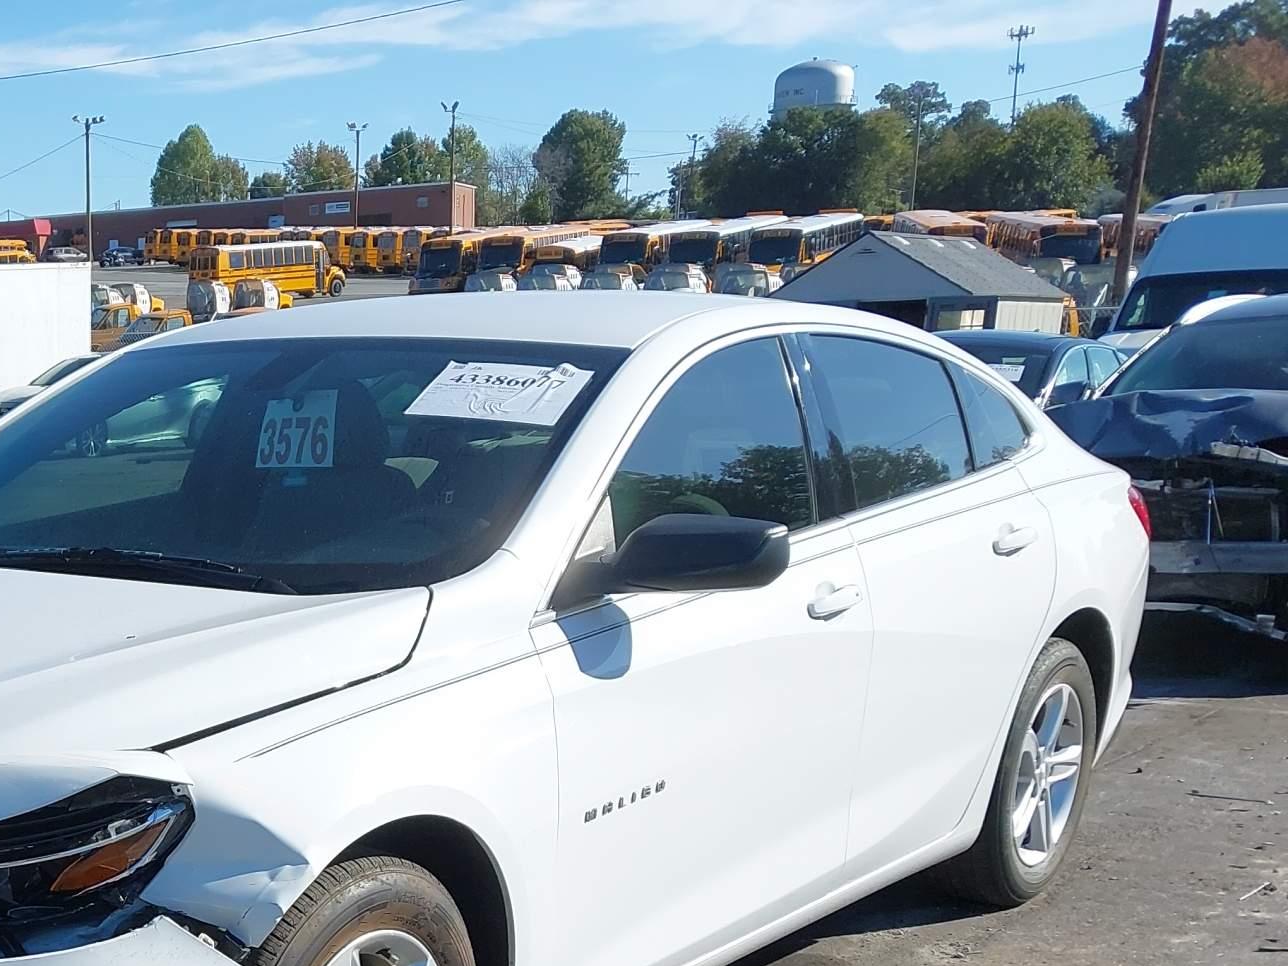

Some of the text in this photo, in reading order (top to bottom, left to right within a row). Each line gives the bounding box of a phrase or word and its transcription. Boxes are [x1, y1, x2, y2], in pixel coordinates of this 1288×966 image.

[450, 373, 567, 389] 43386077
[259, 416, 329, 465] 3576
[583, 778, 667, 824] MALIBU
